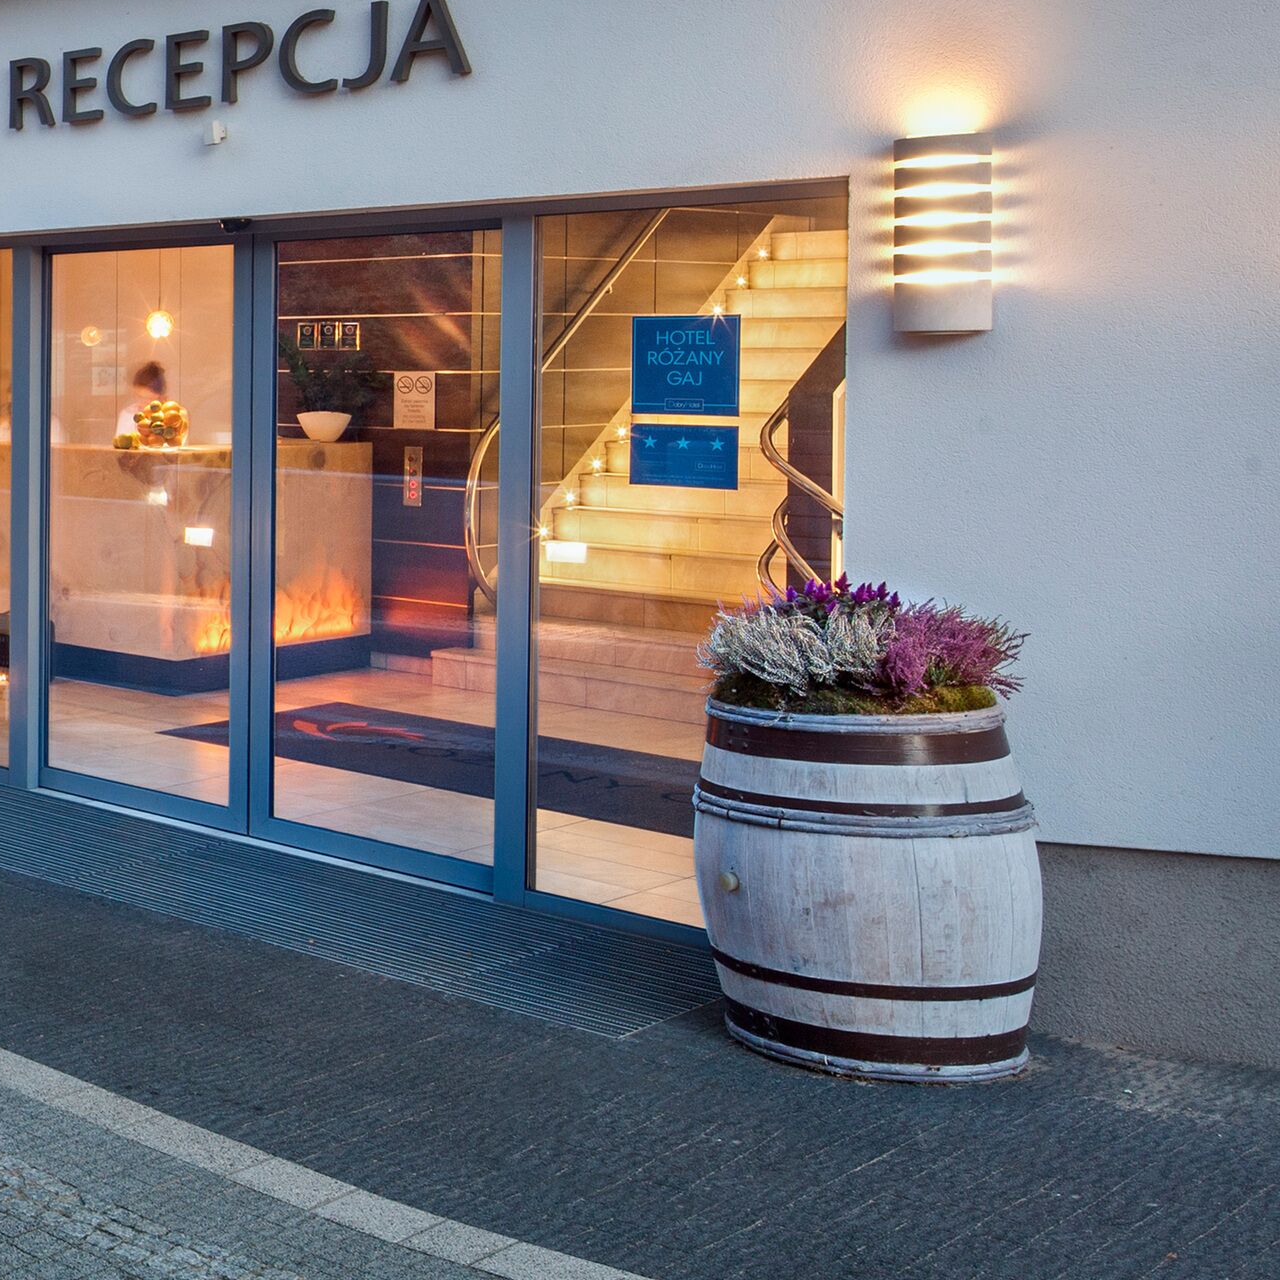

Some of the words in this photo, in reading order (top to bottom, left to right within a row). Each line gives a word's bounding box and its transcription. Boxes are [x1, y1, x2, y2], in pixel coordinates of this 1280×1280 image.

[656, 330, 716, 345] HOTEL
[647, 347, 725, 366] RÓŻANY
[666, 370, 703, 386] GAJ
